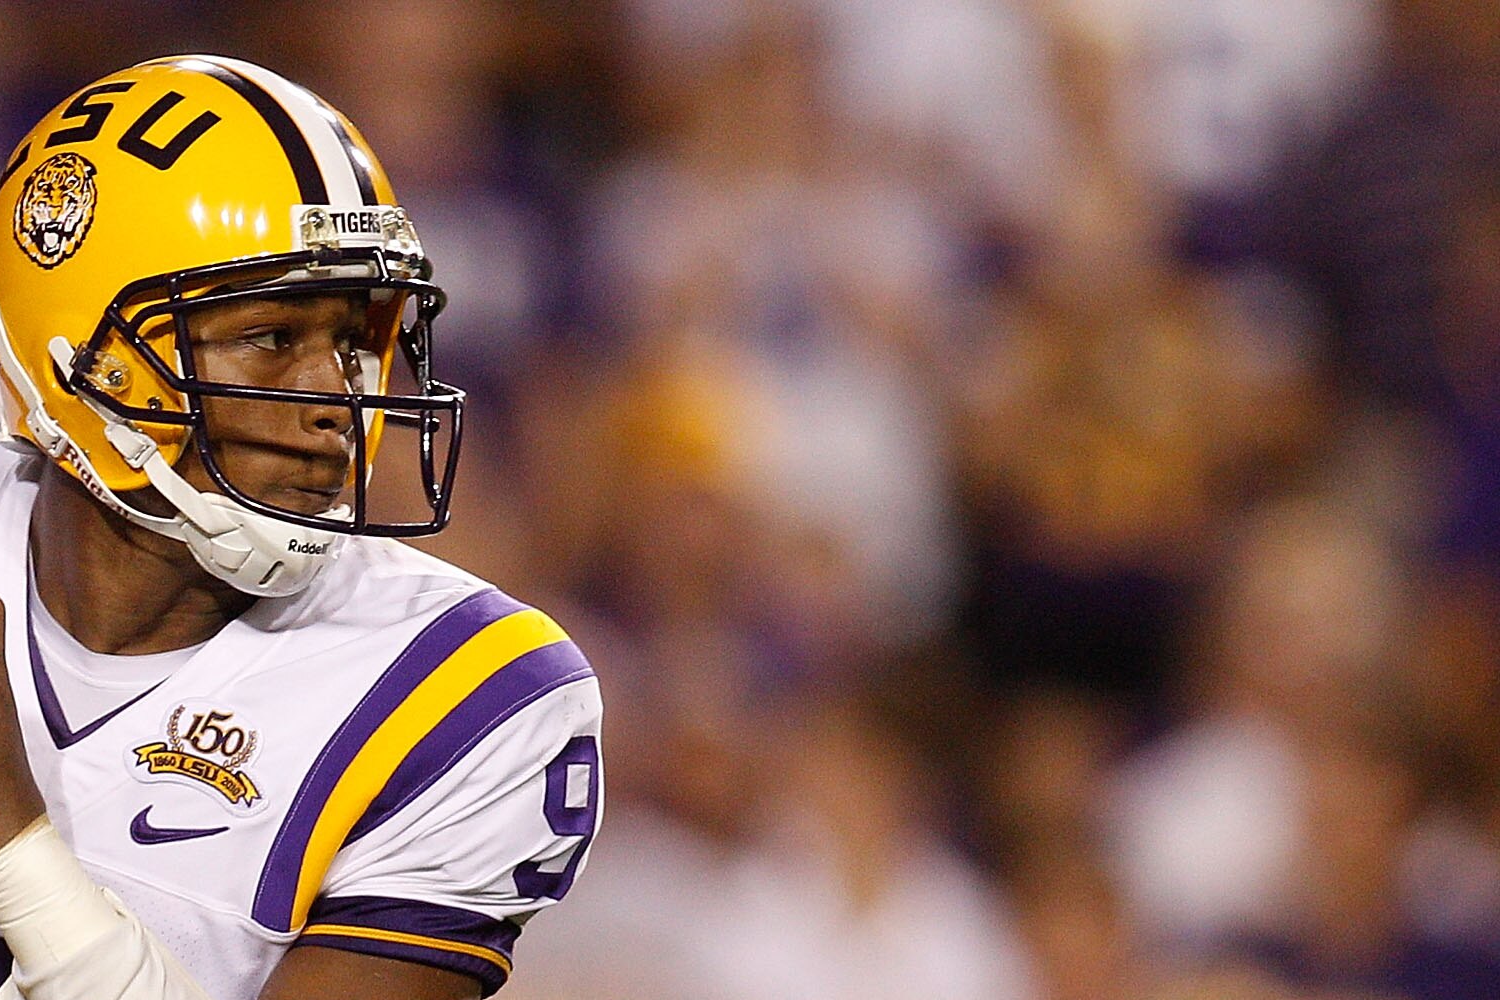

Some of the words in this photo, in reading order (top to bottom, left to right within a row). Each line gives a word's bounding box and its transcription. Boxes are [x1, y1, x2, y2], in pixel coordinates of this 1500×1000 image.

[182, 711, 245, 757] 150
[177, 756, 220, 782] LSU
[513, 735, 599, 902] 9
